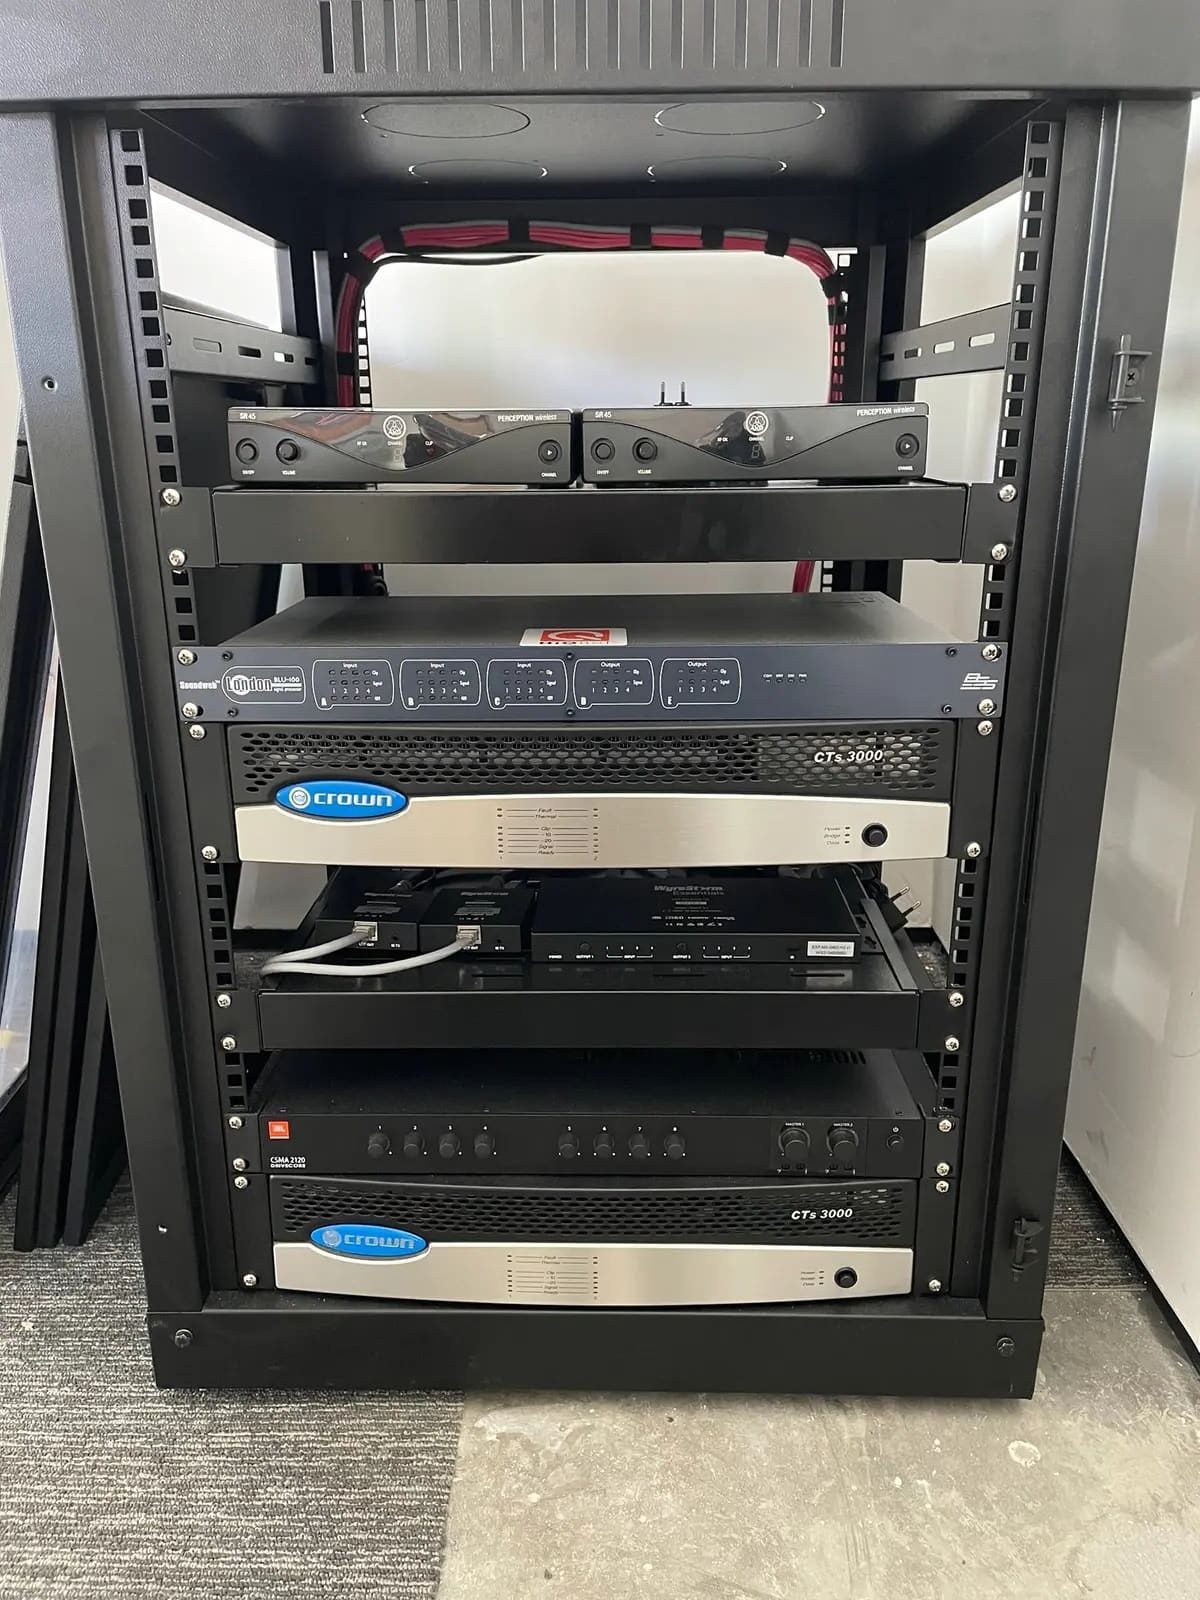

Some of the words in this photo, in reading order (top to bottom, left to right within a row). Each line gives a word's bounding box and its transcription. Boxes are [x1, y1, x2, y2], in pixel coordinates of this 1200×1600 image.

[856, 407, 892, 416] PERCEPTION
[497, 414, 534, 422] PERCEPTION
[180, 681, 218, 690] Soundweb
[226, 675, 272, 692] London
[668, 696, 673, 705] E
[814, 752, 842, 762] CTs
[846, 750, 883, 762] 3000
[791, 1210, 816, 1220] CTs
[820, 1208, 853, 1218] 3000
